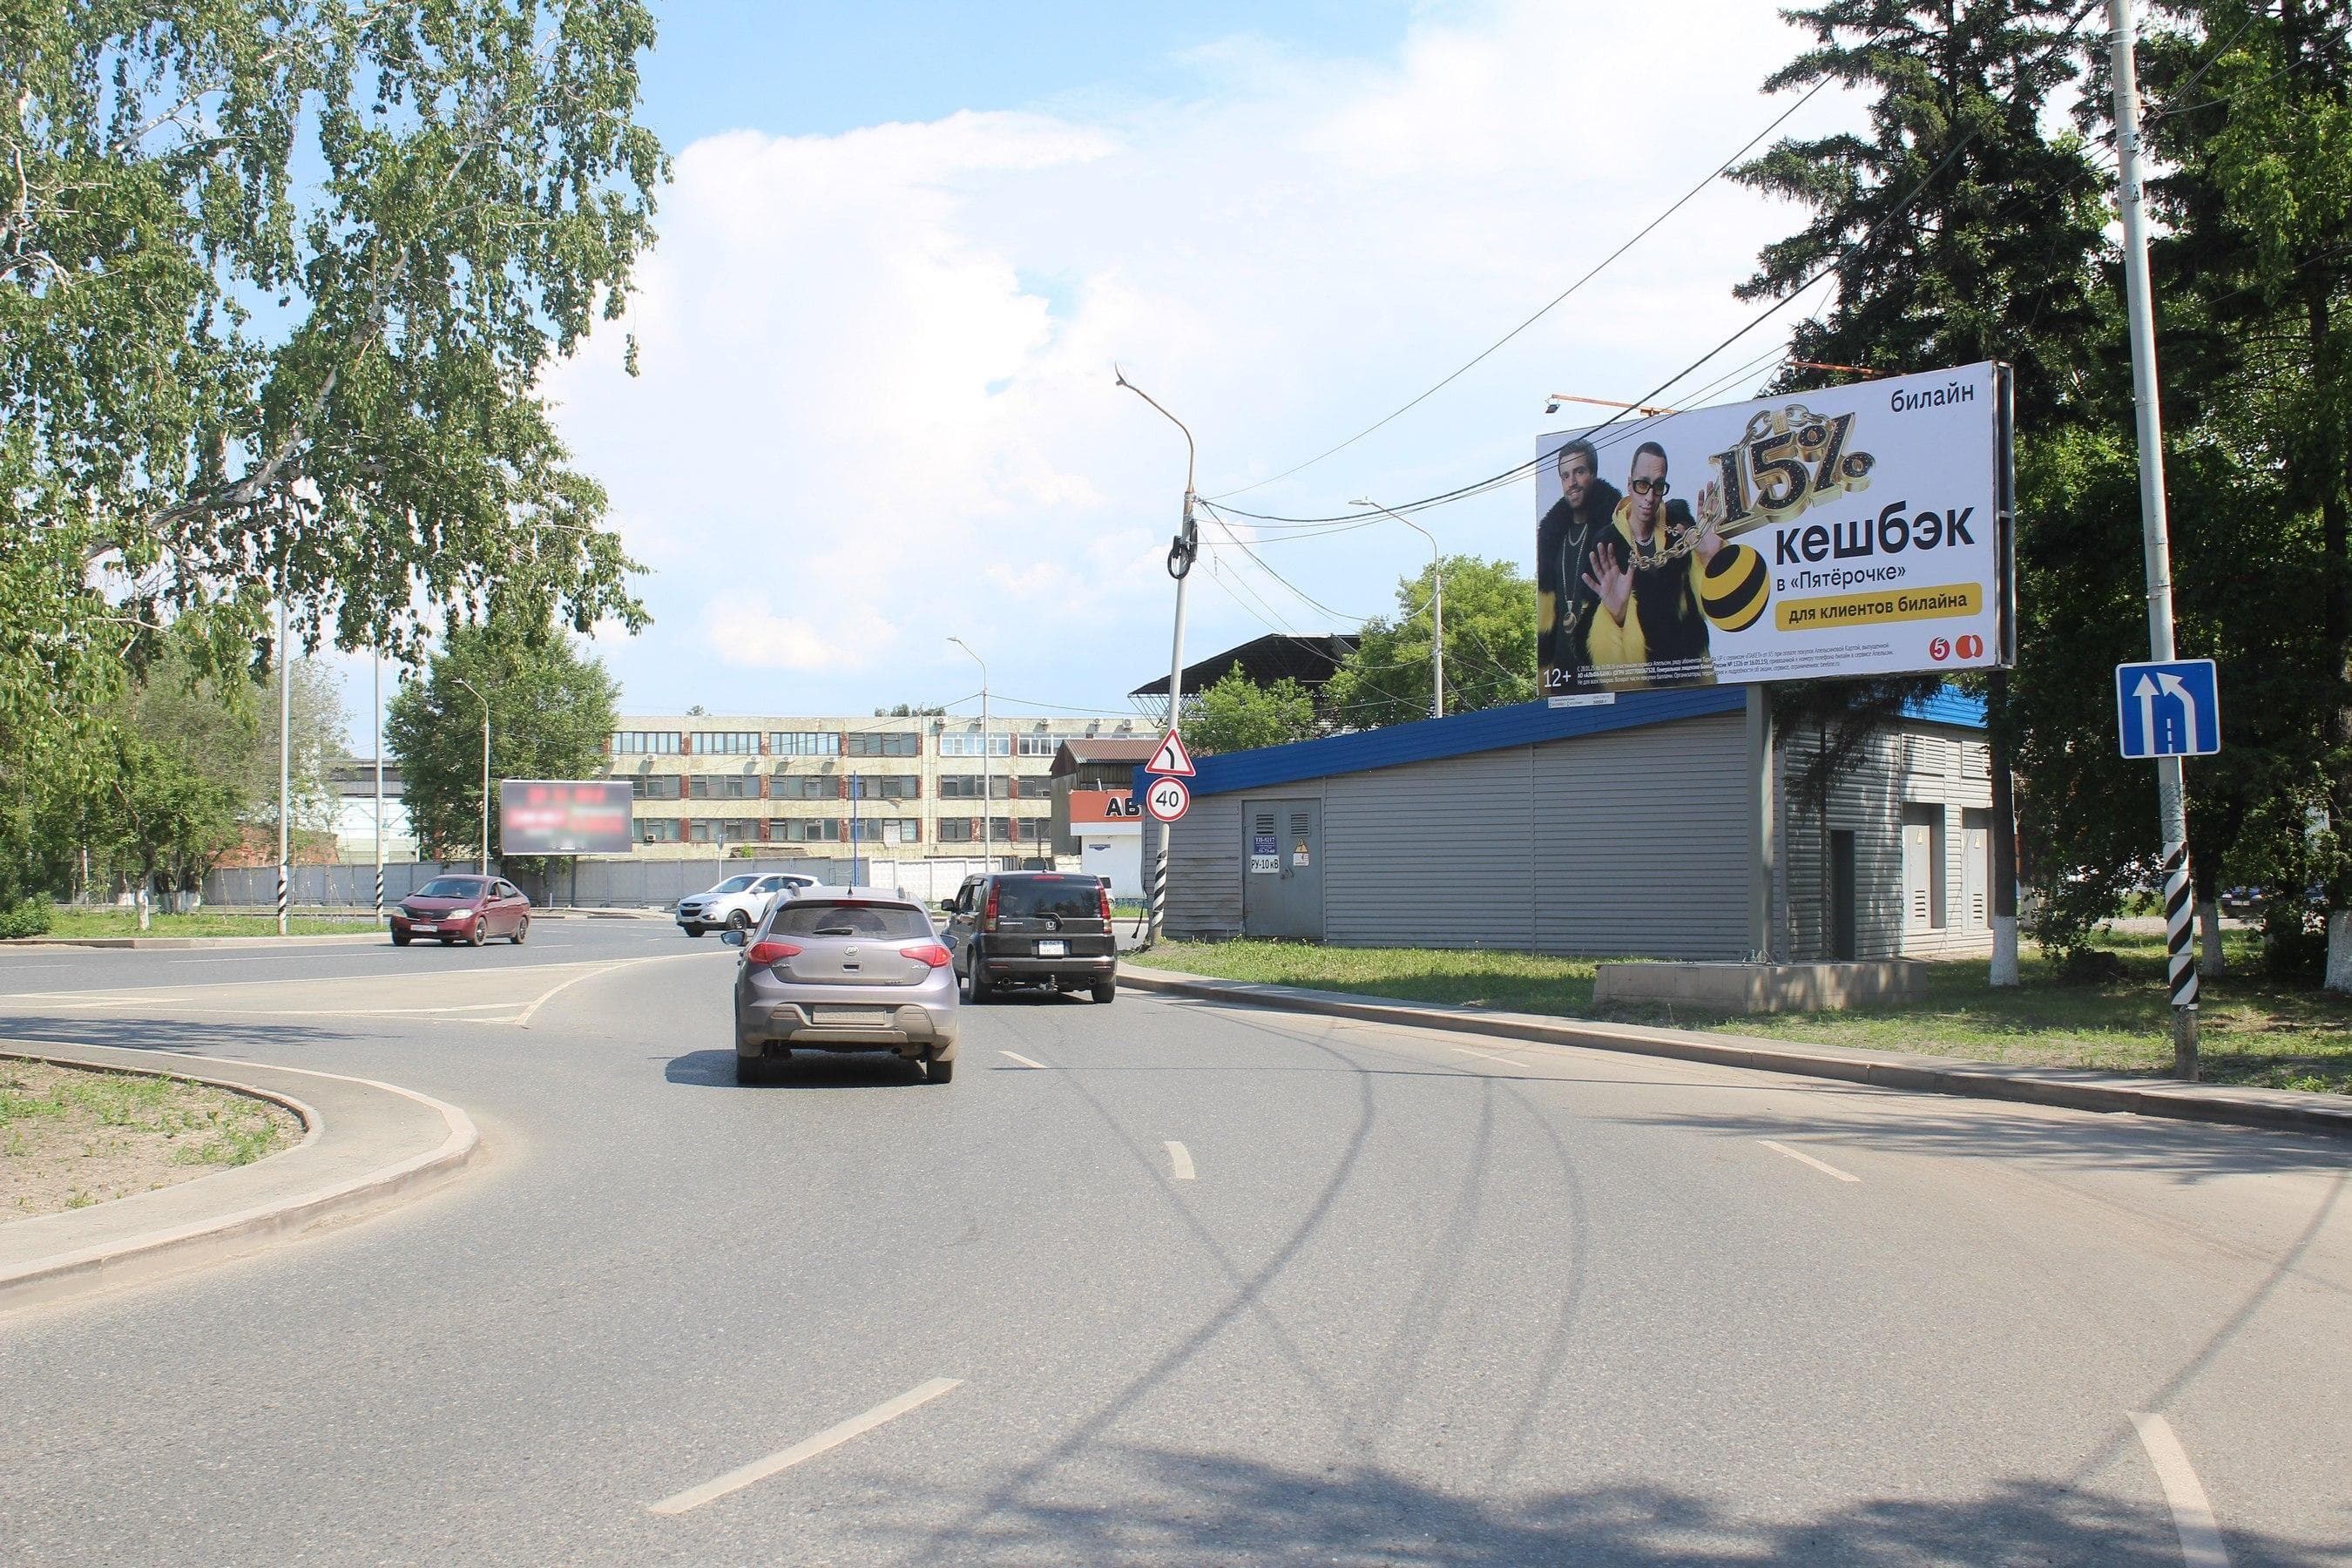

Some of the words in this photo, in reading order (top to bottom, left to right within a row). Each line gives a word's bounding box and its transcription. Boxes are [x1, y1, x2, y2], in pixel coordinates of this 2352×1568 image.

[1891, 382, 1974, 413] билайн
[1709, 412, 1876, 539] 15%
[1776, 500, 1976, 565] кешбэк
[1776, 578, 1785, 591] в
[1790, 565, 1906, 590] «Пятёрочке»
[1788, 606, 1816, 624] для
[1820, 599, 1894, 618] клиентов
[1897, 592, 1968, 612] билайна
[1543, 667, 1571, 688] 12+
[1155, 790, 1179, 808] 40
